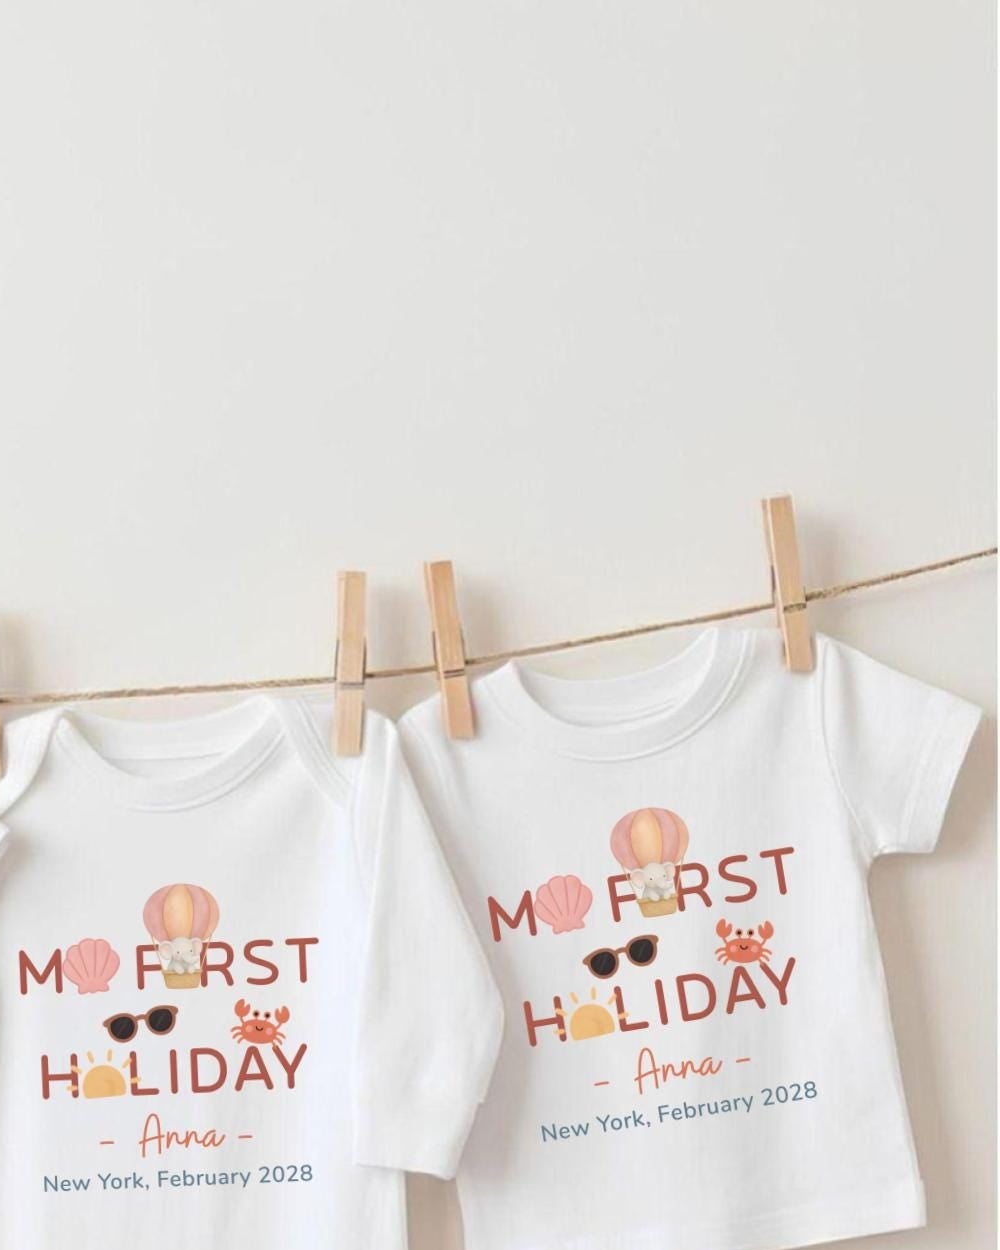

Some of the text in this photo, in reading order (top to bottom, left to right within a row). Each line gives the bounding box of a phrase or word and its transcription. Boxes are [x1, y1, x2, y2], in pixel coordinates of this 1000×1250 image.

[607, 847, 795, 922] FRST
[136, 937, 319, 990] FRST
[524, 957, 796, 1047] HLIDAY
[42, 1043, 307, 1100] HLIDAY
[634, 1048, 722, 1094] Anna
[139, 1113, 225, 1157] Anna
[541, 1081, 818, 1142] New York, February 2028
[43, 1164, 313, 1192] New York, February 2028
